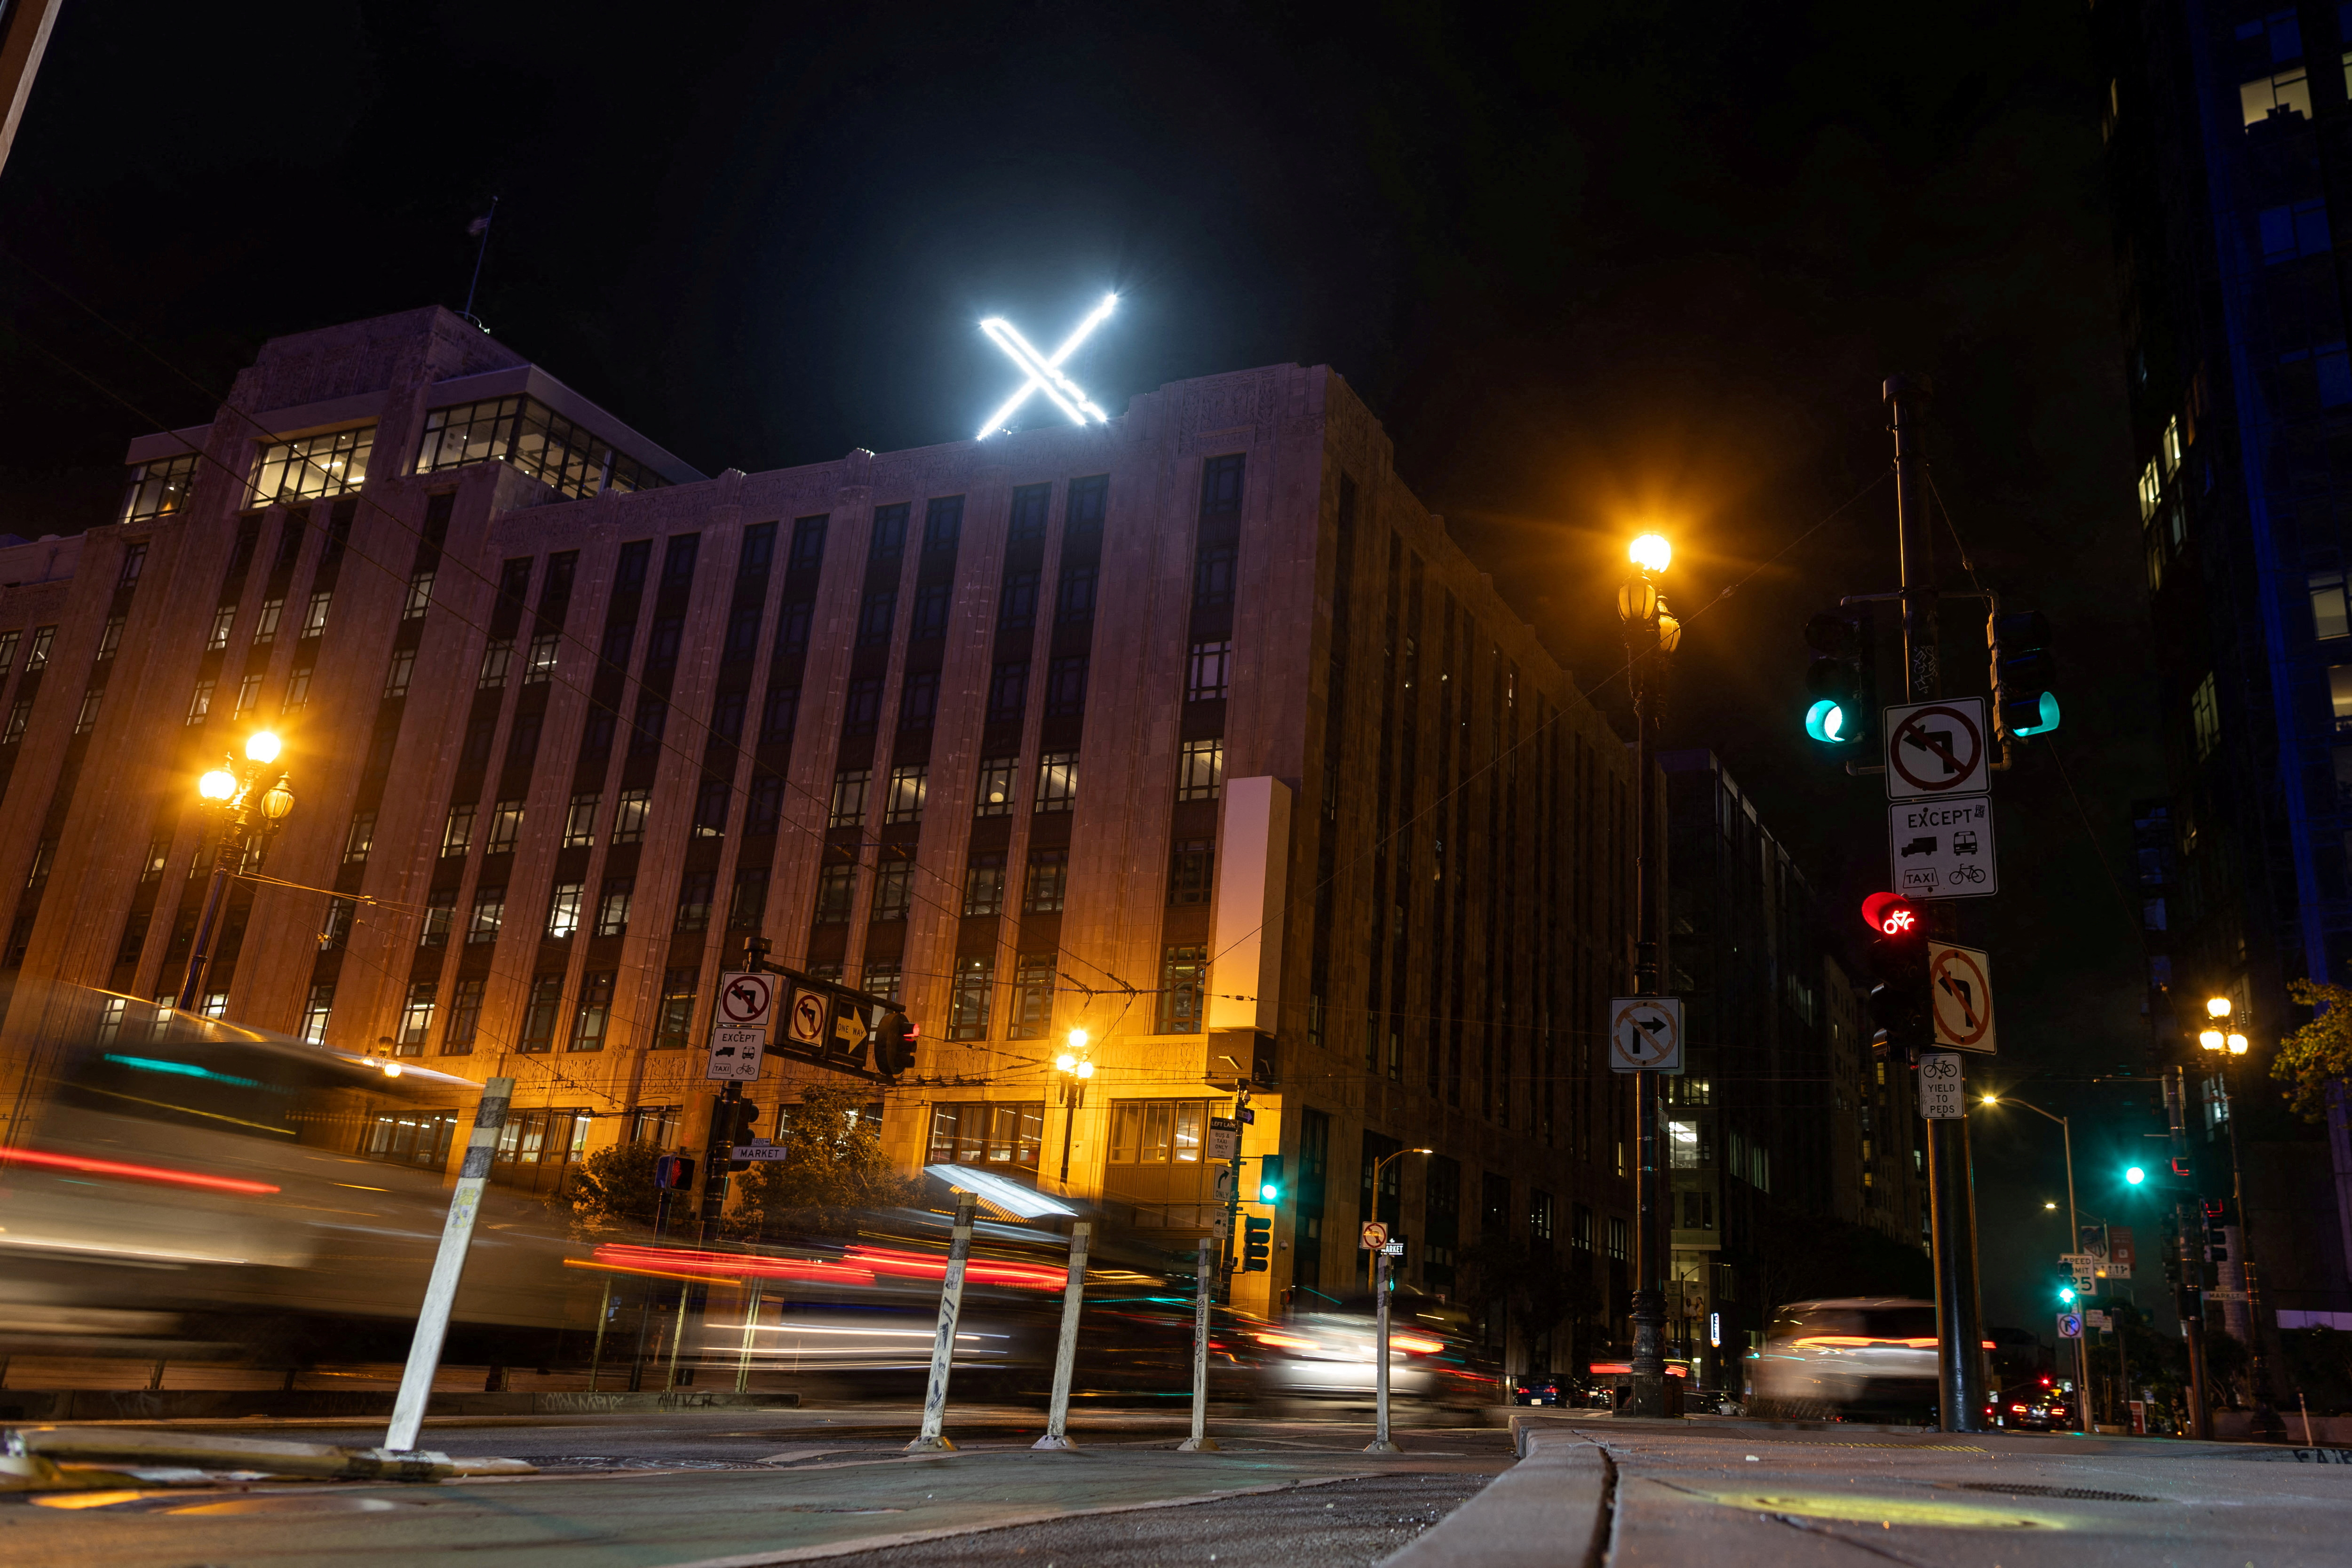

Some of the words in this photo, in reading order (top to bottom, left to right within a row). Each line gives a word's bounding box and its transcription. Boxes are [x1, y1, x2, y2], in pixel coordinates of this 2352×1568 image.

[979, 294, 1115, 439] X
[1908, 809, 1972, 828] EXCEPT
[1906, 873, 1934, 884] TAXI
[838, 1023, 849, 1033] ONE
[853, 1027, 864, 1037] WAY
[722, 1034, 756, 1043] EXCEPT
[1928, 1084, 1955, 1092] YIELD
[1936, 1094, 1947, 1103] TO
[740, 1149, 779, 1158] MARKET
